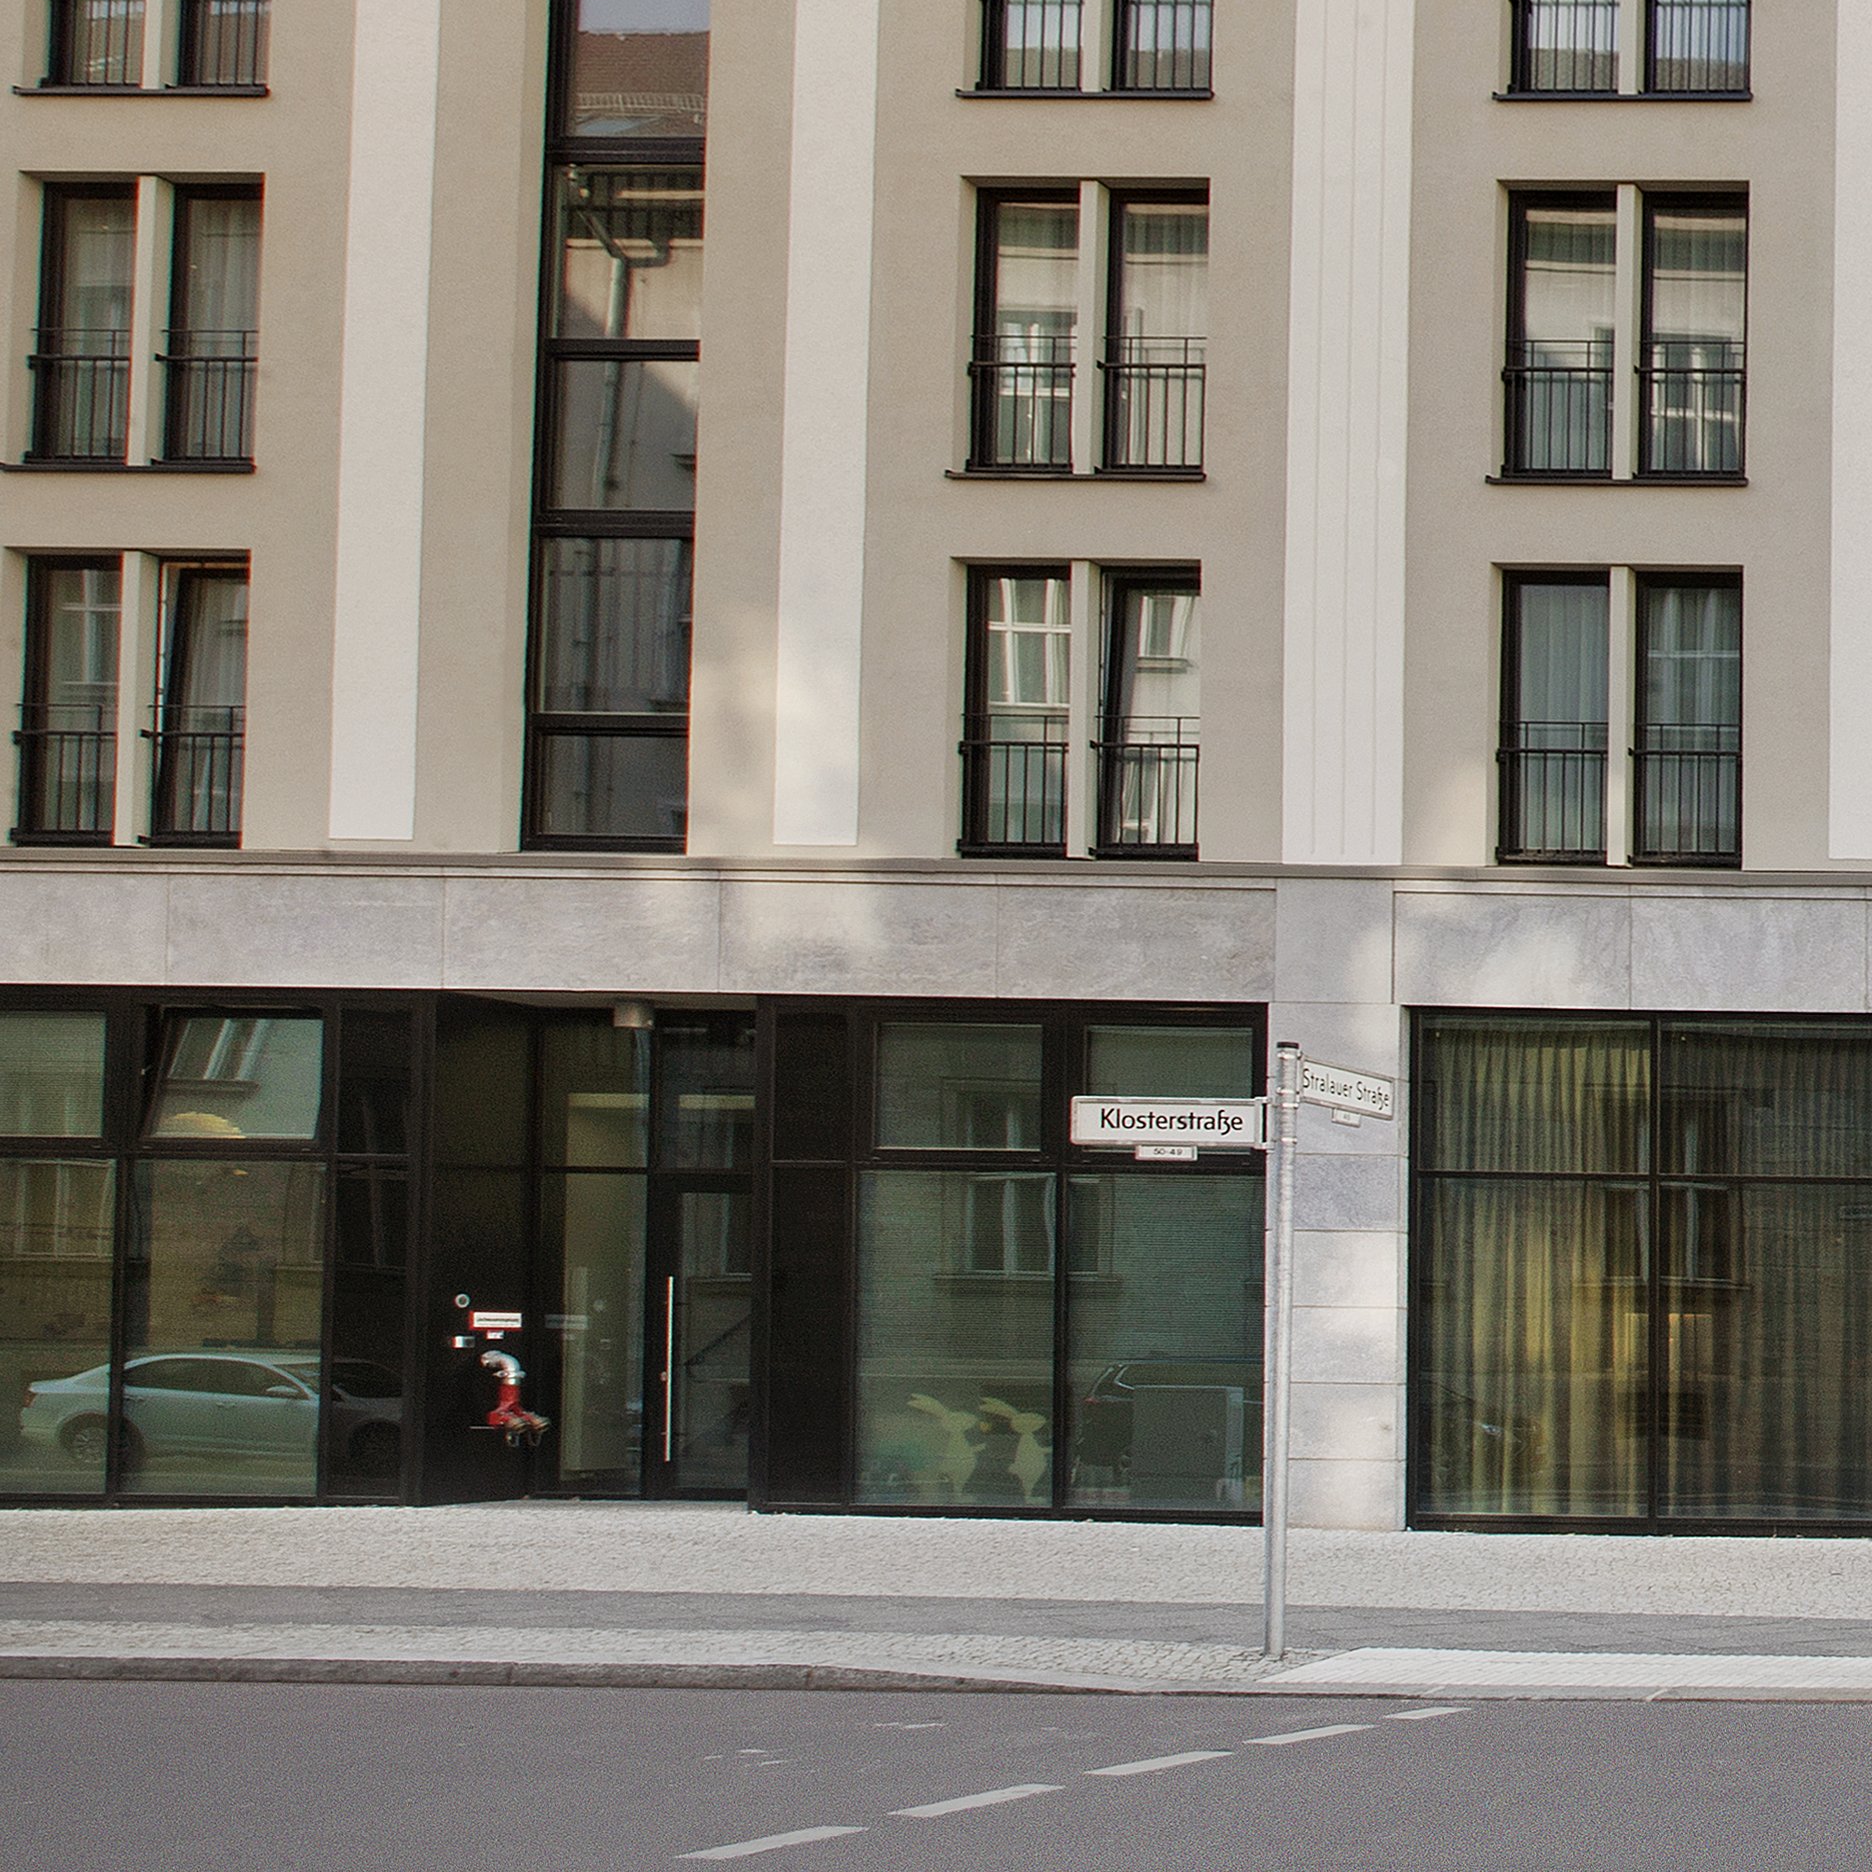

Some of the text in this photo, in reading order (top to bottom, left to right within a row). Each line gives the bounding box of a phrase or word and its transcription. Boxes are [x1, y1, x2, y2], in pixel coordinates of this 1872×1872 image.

[1303, 1068, 1389, 1110] Stralauer Straße
[1100, 1107, 1243, 1135] Klosterstraße
